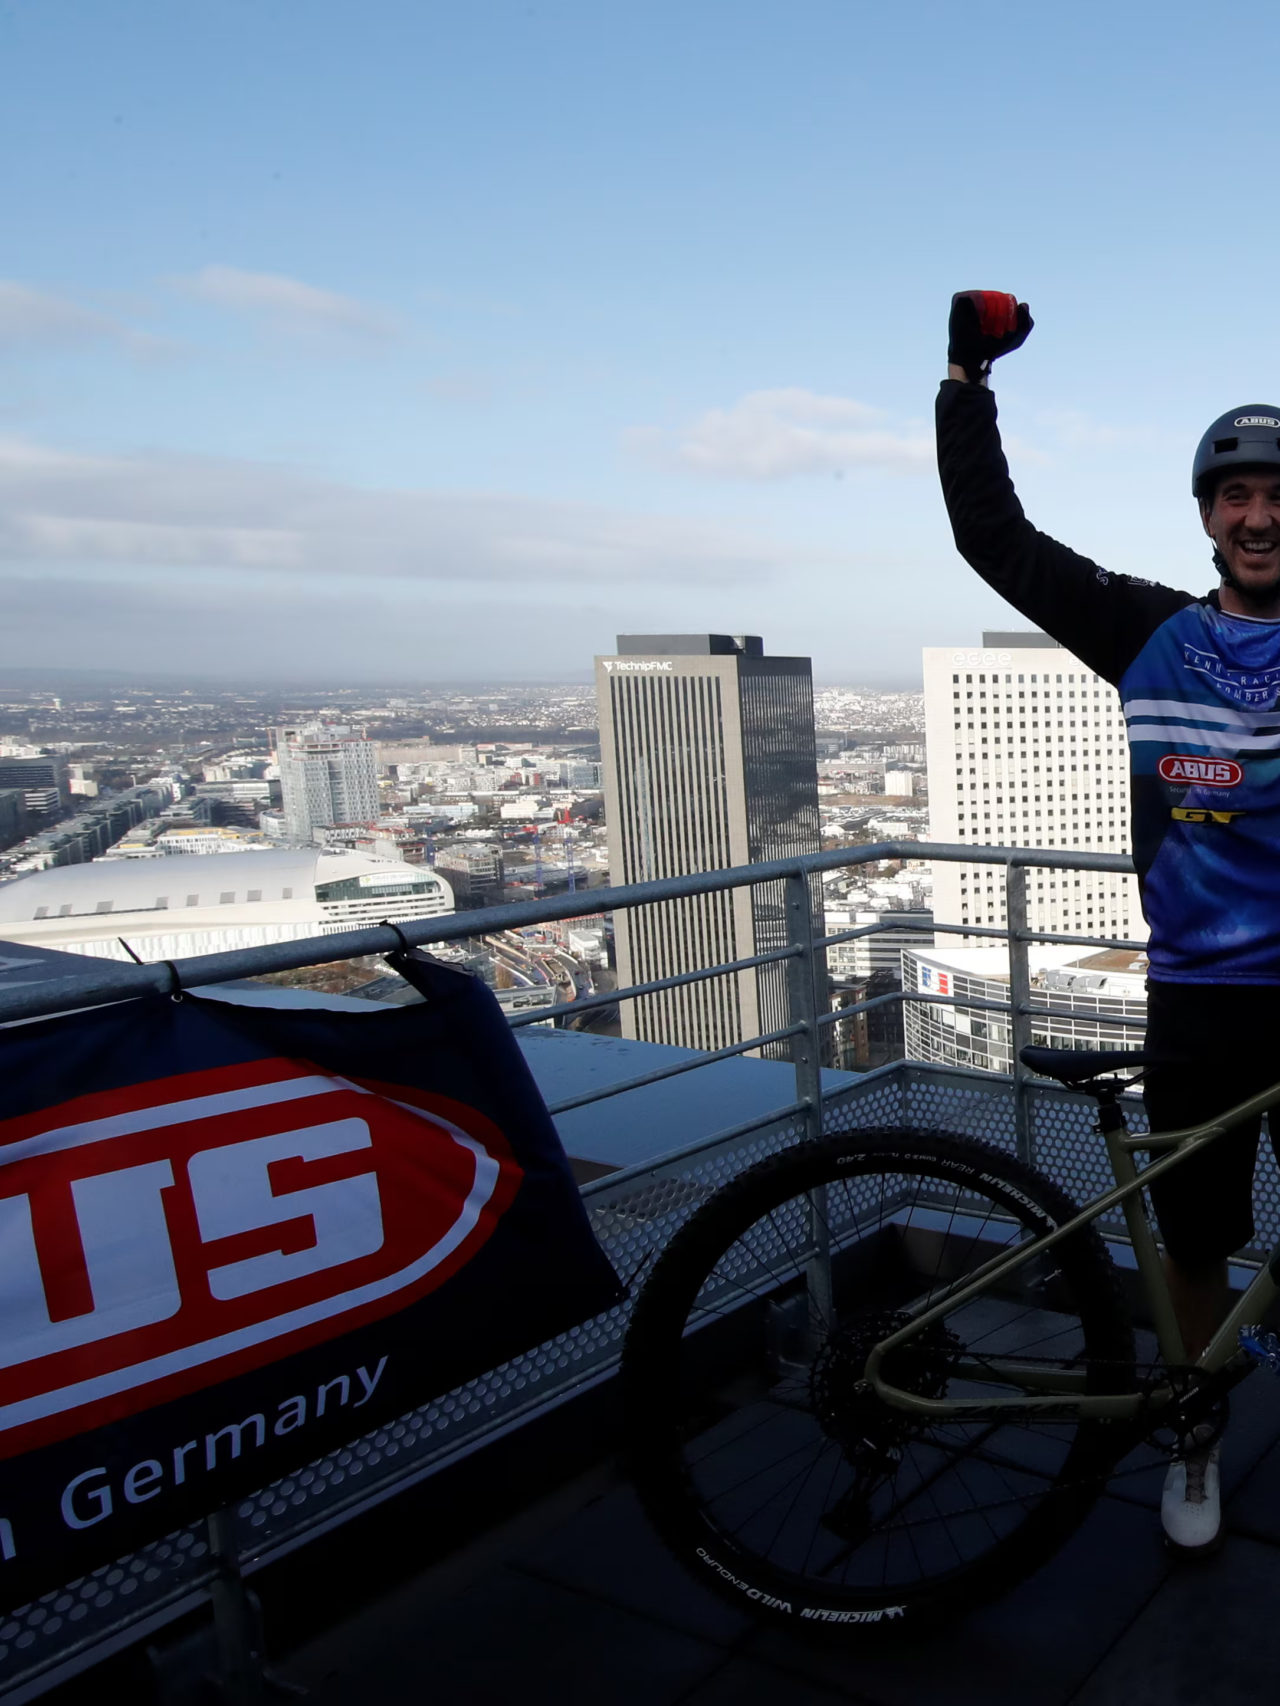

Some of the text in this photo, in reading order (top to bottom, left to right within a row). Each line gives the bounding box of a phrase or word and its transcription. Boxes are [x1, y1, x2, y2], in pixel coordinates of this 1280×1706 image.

[1239, 418, 1275, 426] ABUS
[615, 660, 673, 672] TechnipFMC
[1169, 760, 1231, 781] ABUS
[1171, 807, 1246, 823] GT
[60, 1356, 389, 1530] Germany
[800, 1607, 882, 1624] MICHELIN
